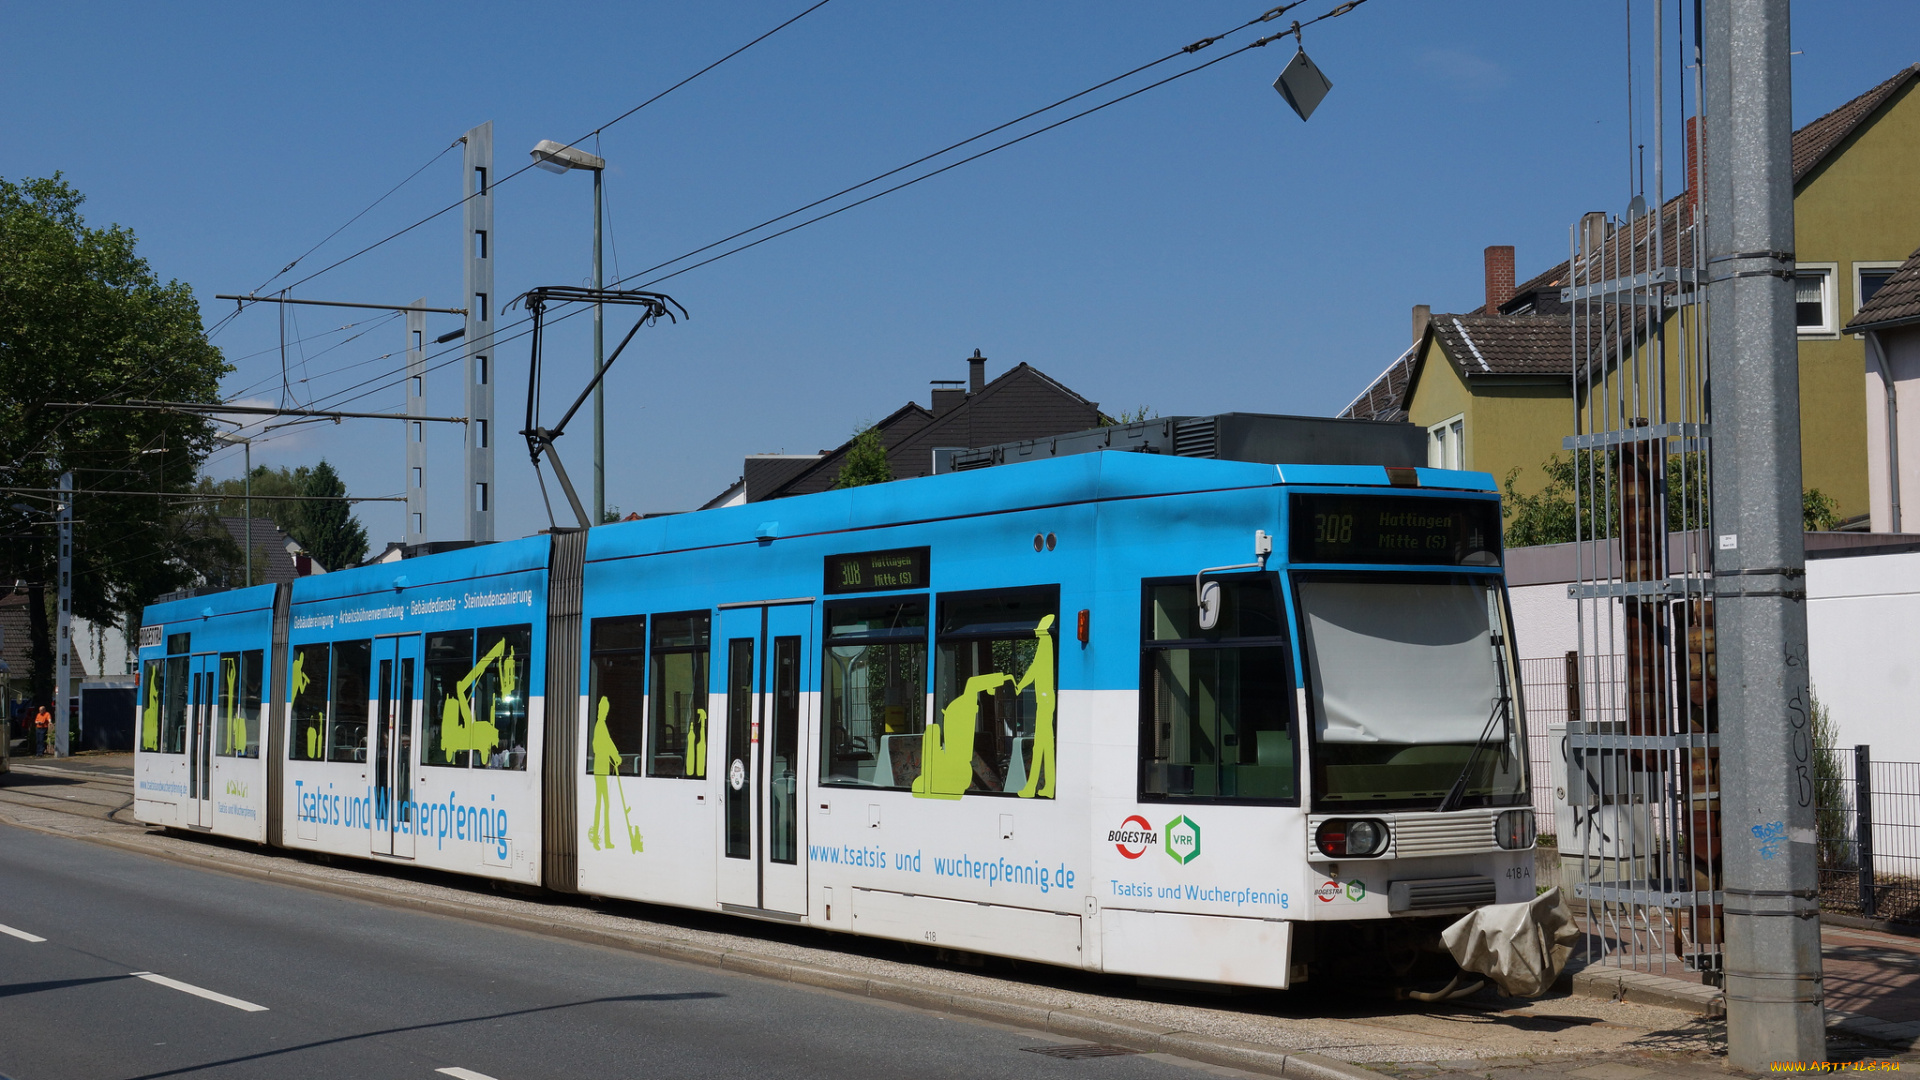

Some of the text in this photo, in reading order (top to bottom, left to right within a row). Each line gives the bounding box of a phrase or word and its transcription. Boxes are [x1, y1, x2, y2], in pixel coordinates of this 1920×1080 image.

[1379, 512, 1451, 528] Hattingen
[1314, 513, 1353, 543] 308
[1379, 535, 1447, 549] Mitte (S)
[872, 556, 912, 568] Hattingen
[841, 561, 861, 585] 308
[874, 571, 912, 586] Mitte (S)
[410, 597, 456, 616] Gebäudedienste
[464, 588, 533, 607] Steinbodensanierung
[296, 780, 507, 860] Tsatsis und Wucherpfennig
[1108, 830, 1157, 844] BOGESTRA
[1173, 835, 1193, 845] VRR
[809, 845, 1075, 893] www.tsatsis und wucherpfennig.de
[1506, 867, 1530, 879] 418 A
[1111, 880, 1289, 909] Tsatsis und Wucherpfennig
[925, 931, 937, 942] 418
